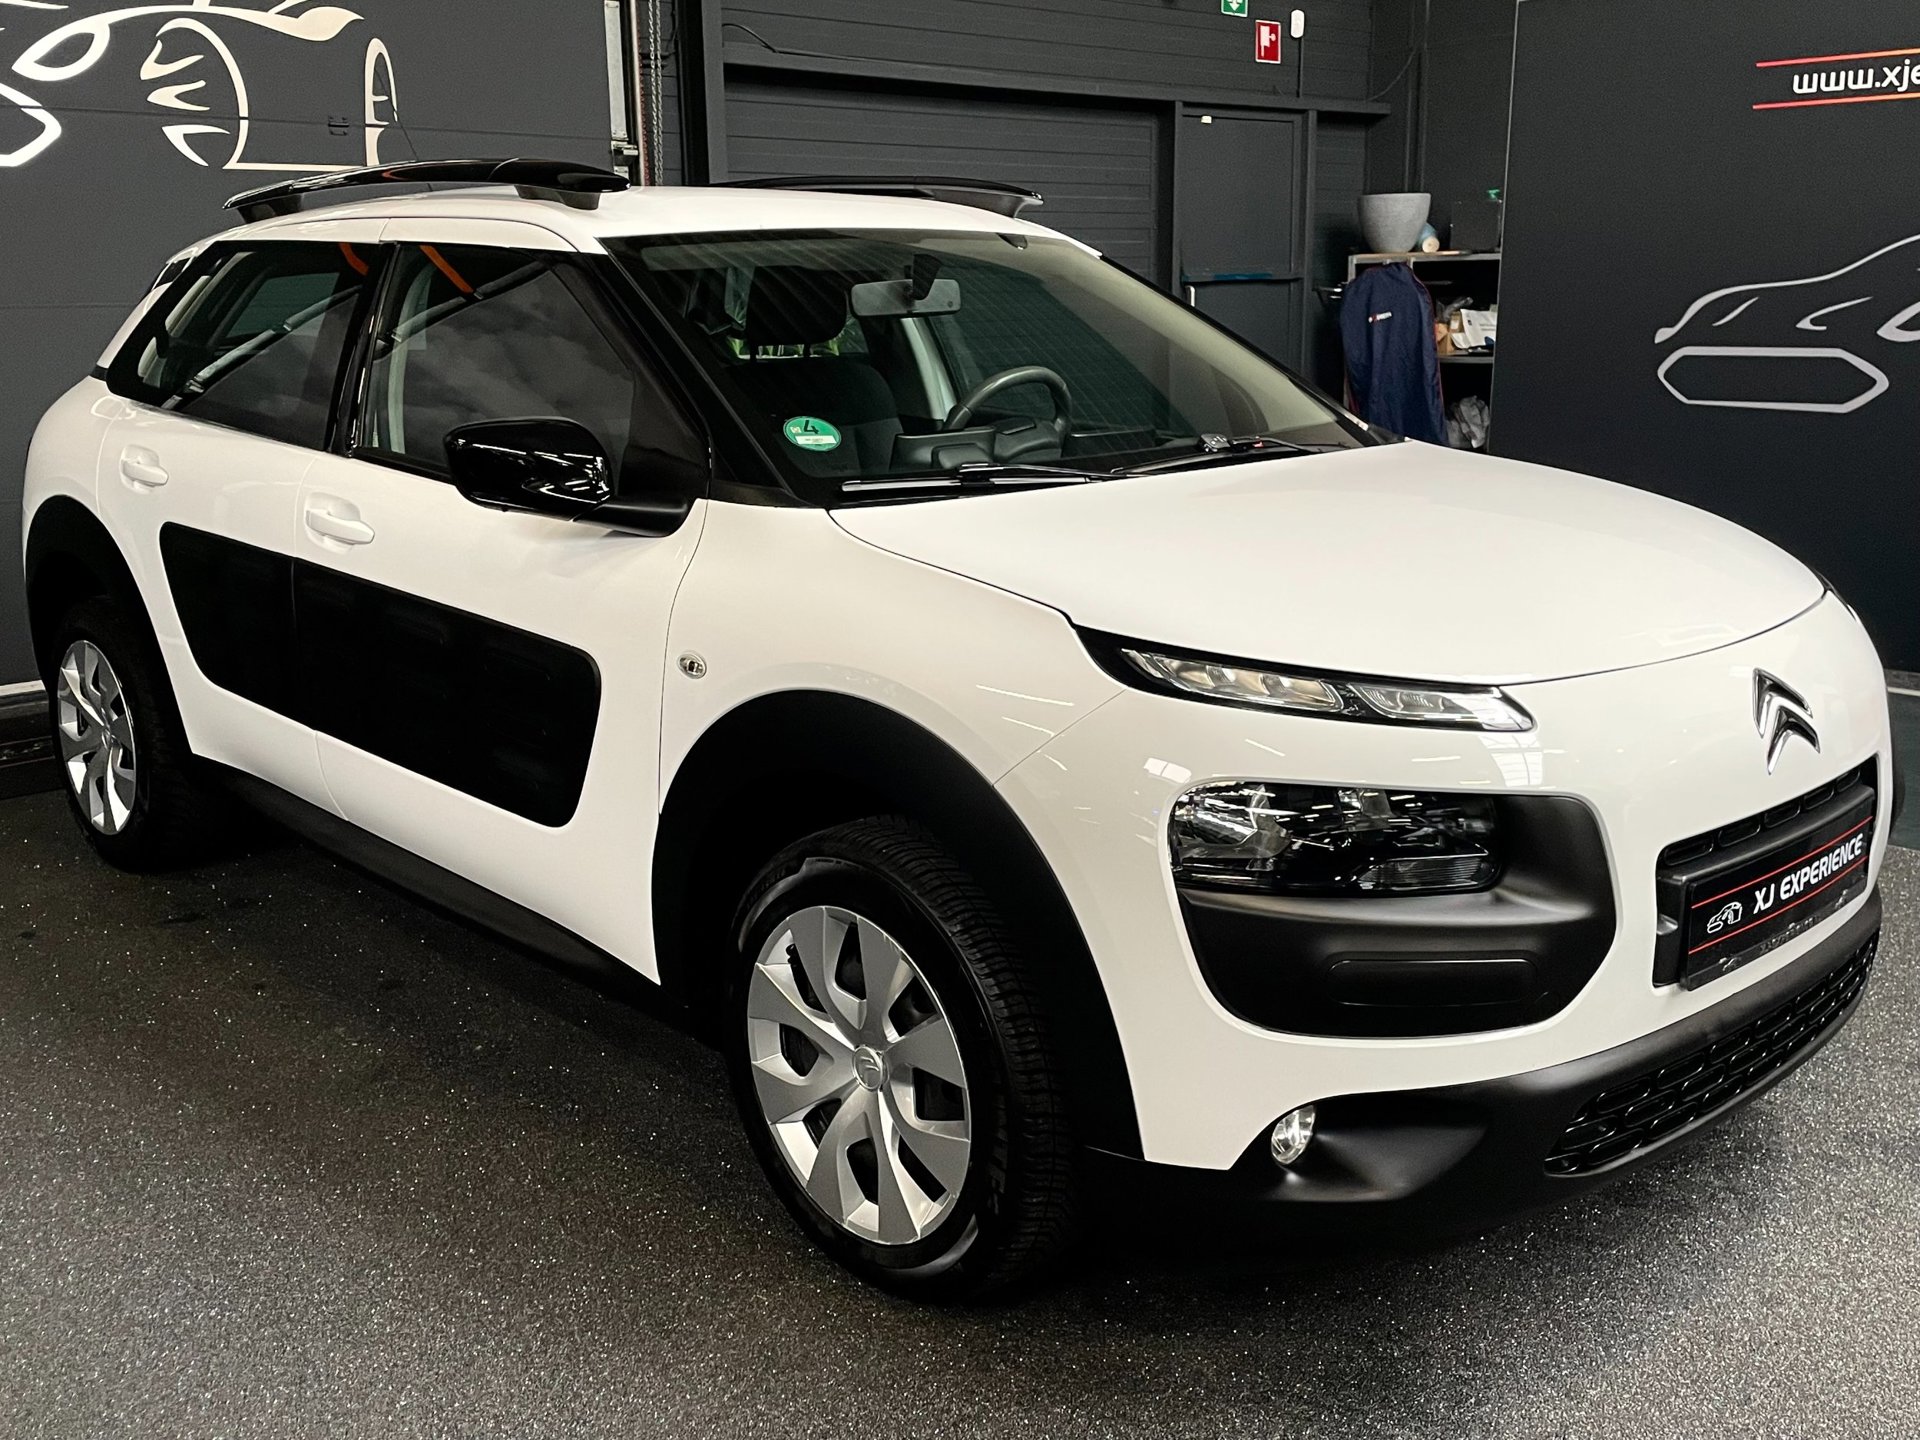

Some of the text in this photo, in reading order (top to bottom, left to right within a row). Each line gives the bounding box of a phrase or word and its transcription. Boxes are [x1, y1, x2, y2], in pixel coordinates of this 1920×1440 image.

[804, 420, 819, 434] 4
[1753, 833, 1863, 914] XJ EXPERIENCE
